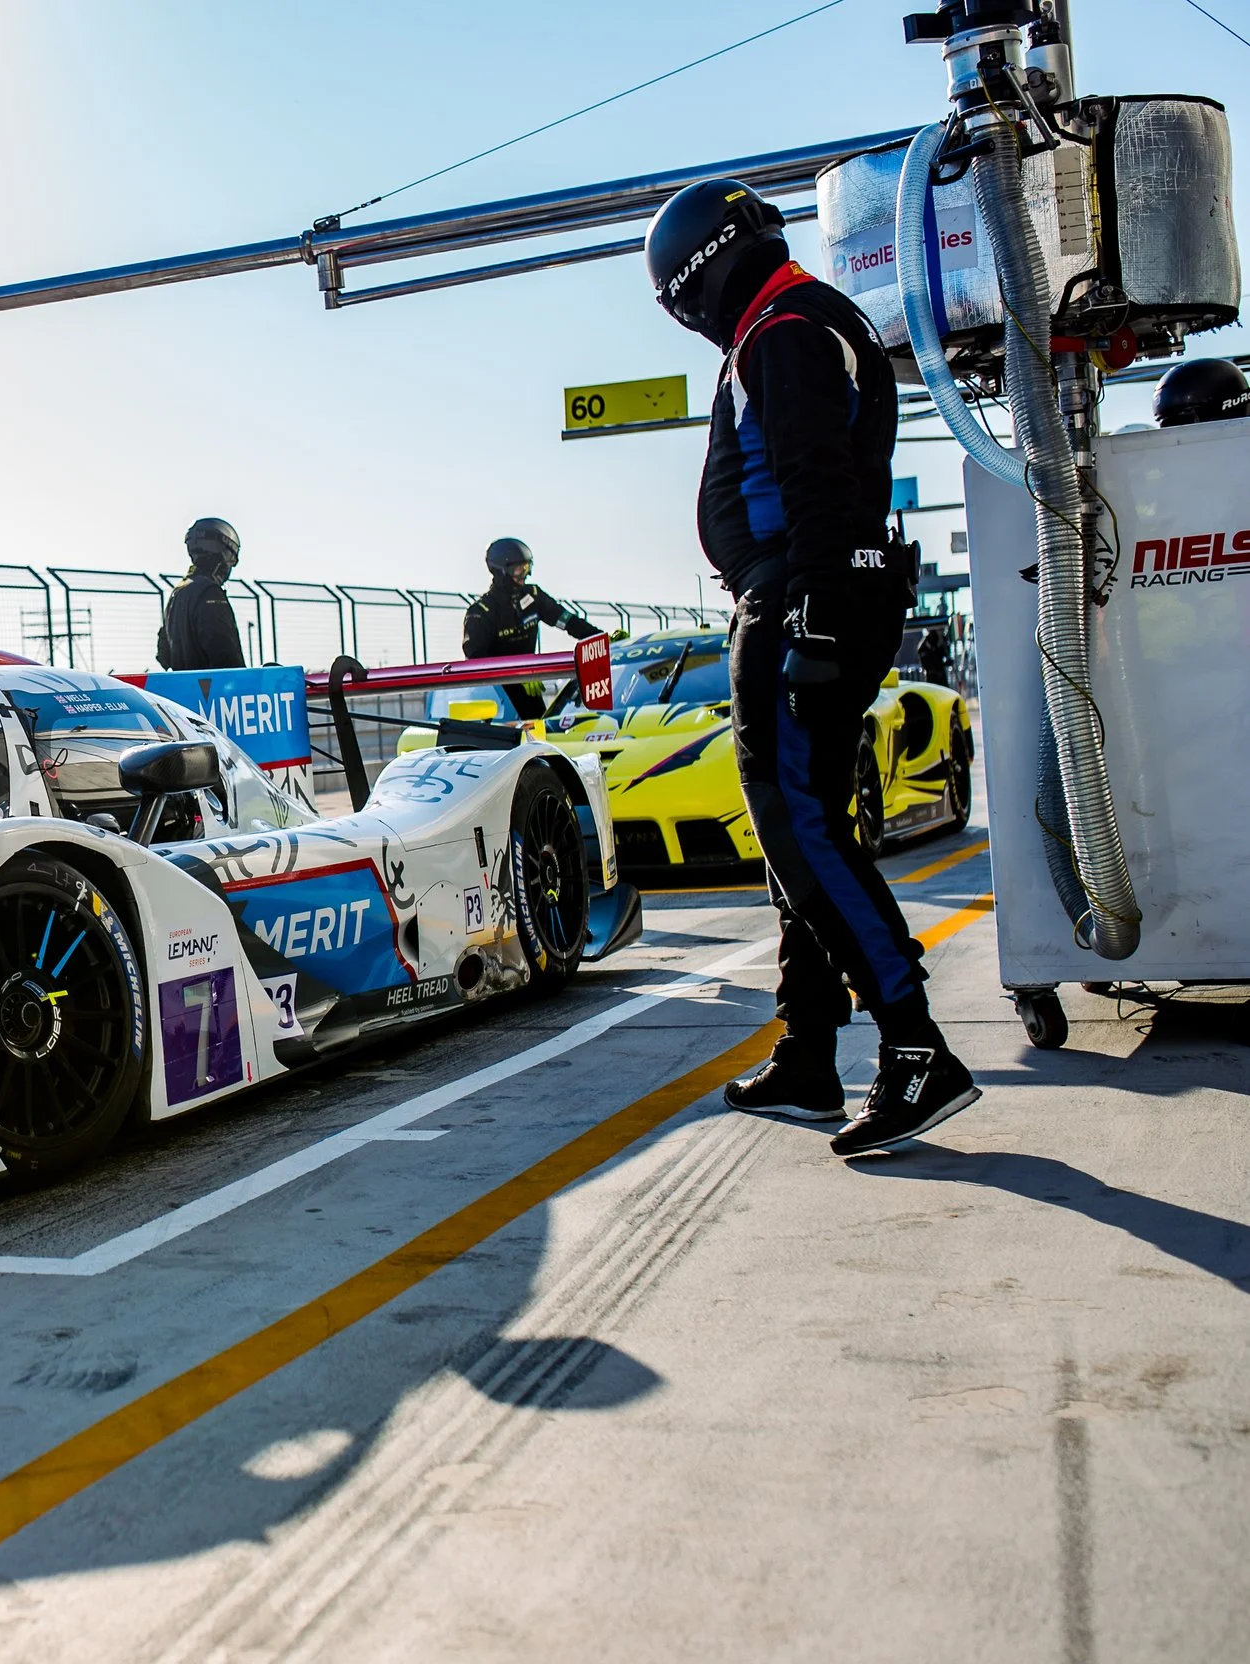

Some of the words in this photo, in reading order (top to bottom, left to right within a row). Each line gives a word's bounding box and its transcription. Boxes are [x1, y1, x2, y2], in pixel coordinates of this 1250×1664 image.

[571, 393, 606, 421] 60
[1130, 567, 1225, 590] RACING
[581, 638, 608, 664] MOTUL
[63, 693, 92, 702] WELLS
[465, 893, 483, 927] P3
[169, 928, 193, 939] EUROPEAN
[254, 898, 371, 959] MERIT
[188, 957, 206, 968] SERIES
[113, 931, 142, 1051] MICHELIN
[386, 985, 414, 1007] HEEL
[416, 977, 449, 1000] TREAD
[183, 980, 213, 1088] 7
